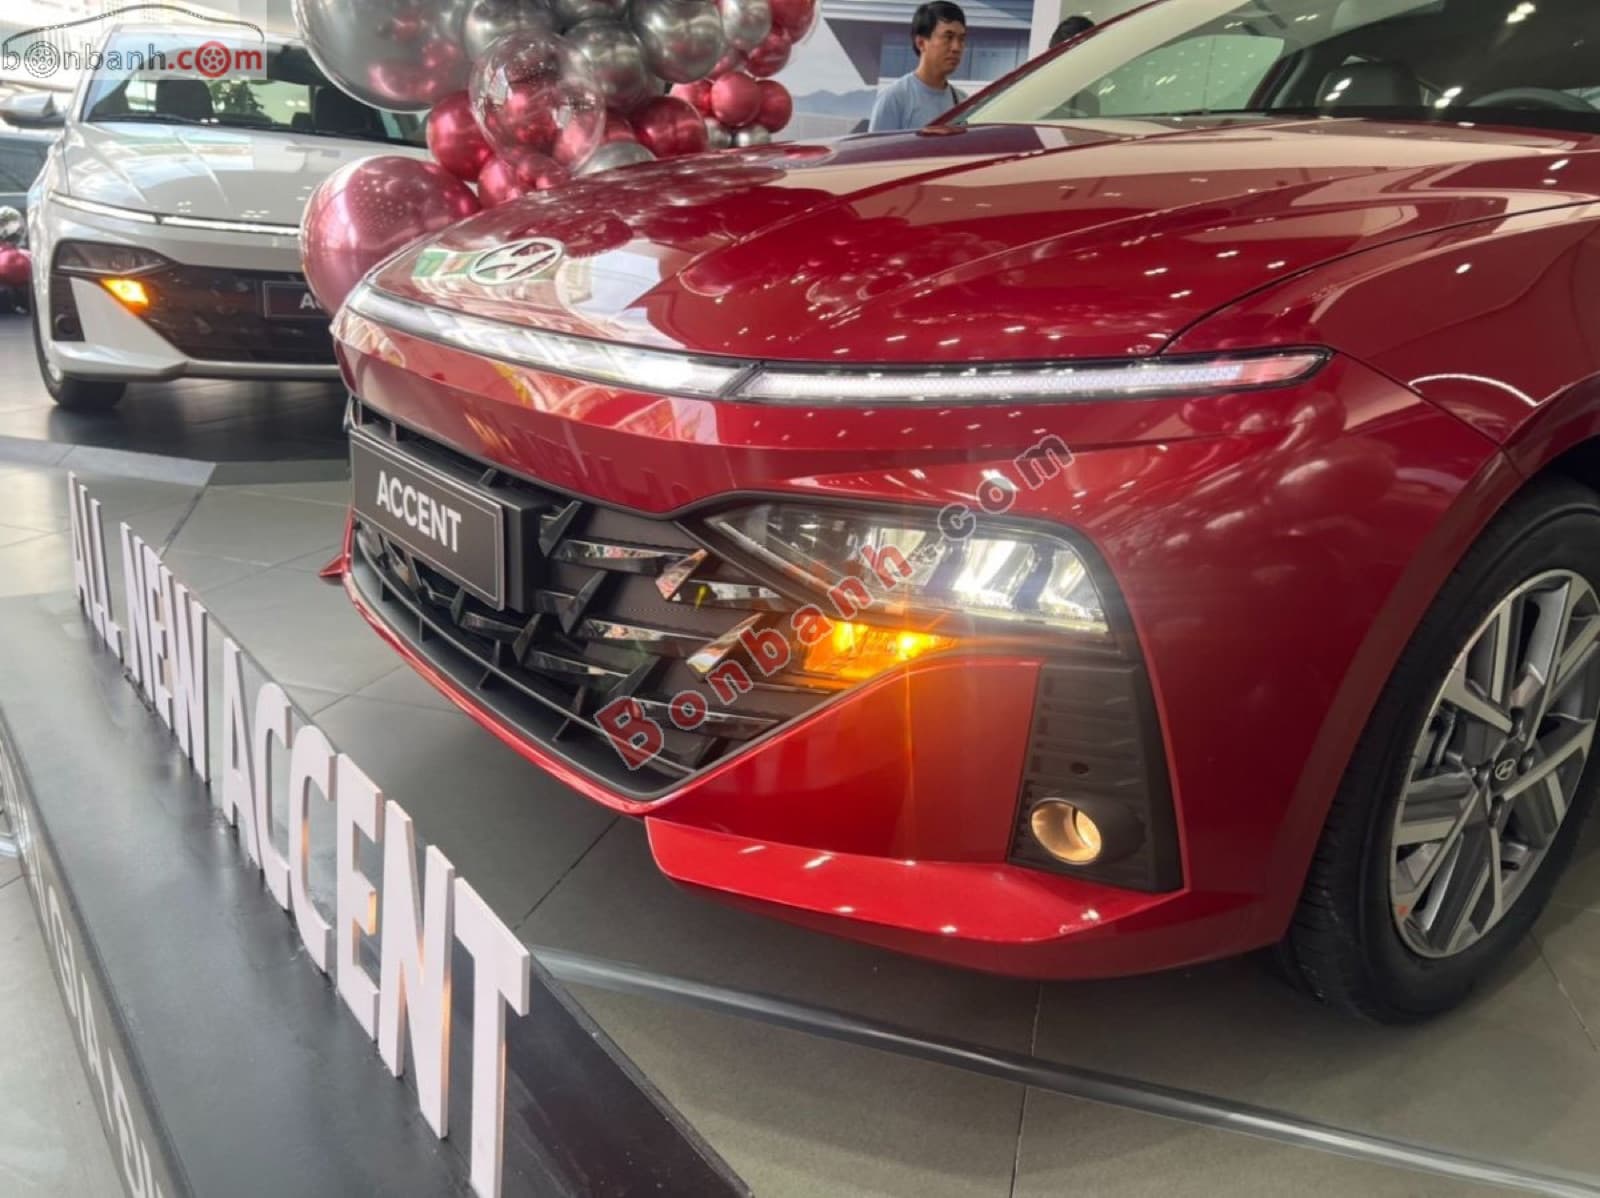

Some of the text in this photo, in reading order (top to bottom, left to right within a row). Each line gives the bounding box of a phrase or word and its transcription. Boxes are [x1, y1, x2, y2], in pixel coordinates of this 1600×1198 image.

[376, 471, 462, 552] ACCENT
[67, 471, 530, 1198] ALL NEW ACCENT
